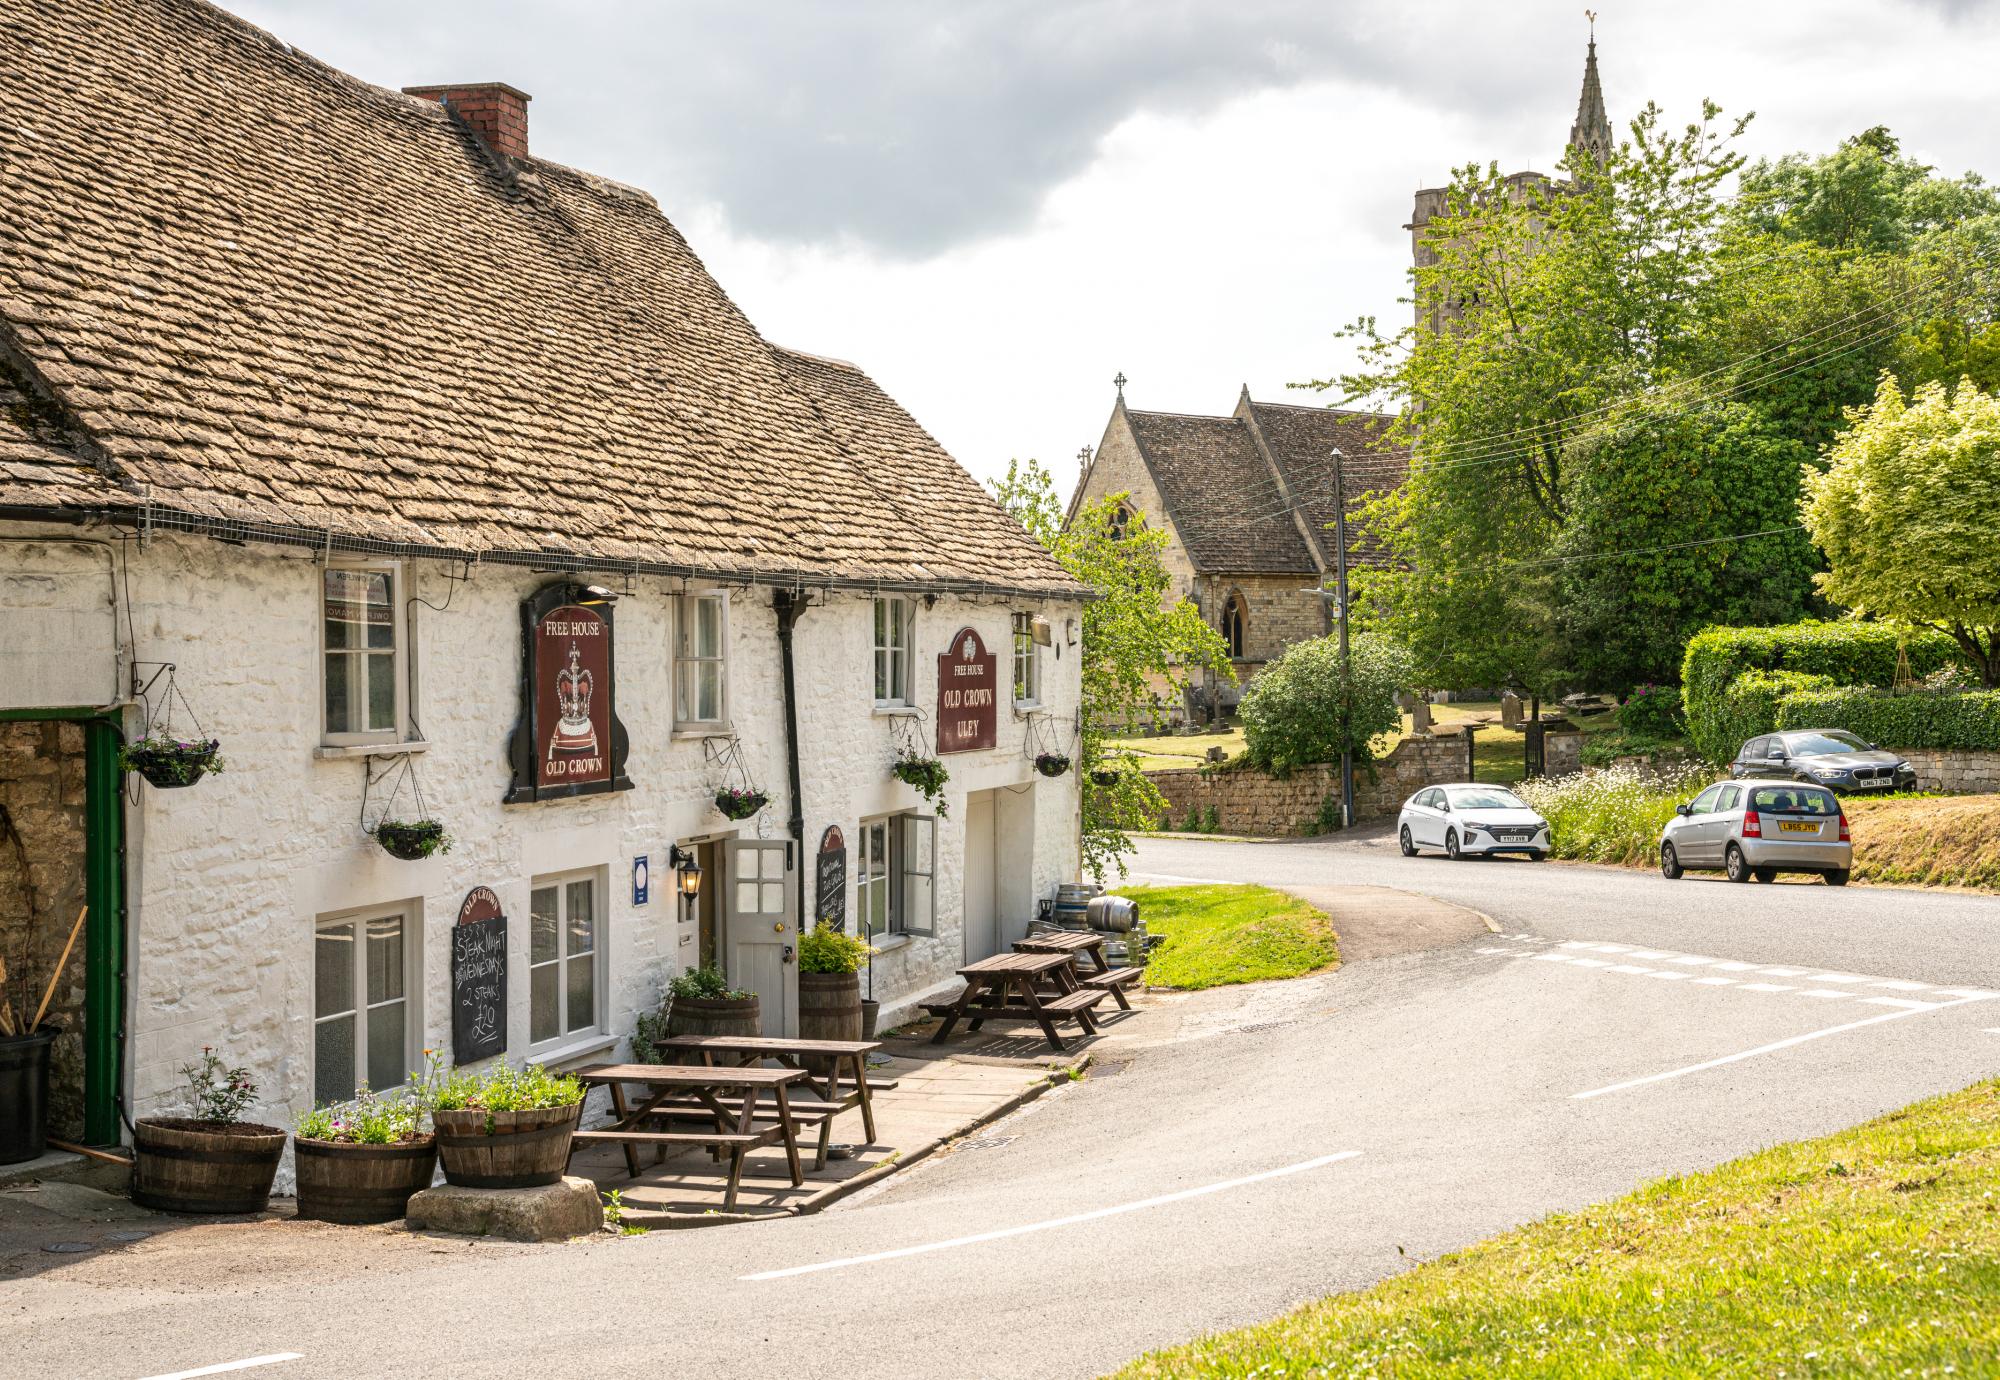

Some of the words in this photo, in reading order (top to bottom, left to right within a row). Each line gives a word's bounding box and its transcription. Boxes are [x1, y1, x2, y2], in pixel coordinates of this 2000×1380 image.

[546, 621, 569, 636] FREE
[571, 621, 600, 636] HOUSE
[954, 665, 967, 676] FREE
[967, 664, 984, 676] HOUSE
[944, 690, 961, 708] OLD
[964, 689, 992, 707] CROWN
[957, 720, 979, 738] ULEY
[546, 760, 566, 776] OLD
[569, 757, 603, 774] CROWN
[1783, 823, 1802, 831] LB55
[464, 893, 477, 915] OLD
[477, 889, 499, 911] CROWN
[457, 937, 486, 962] STEAK
[462, 987, 473, 1006] 2
[474, 985, 500, 1001] STEAKS
[471, 1004, 495, 1039] £20
